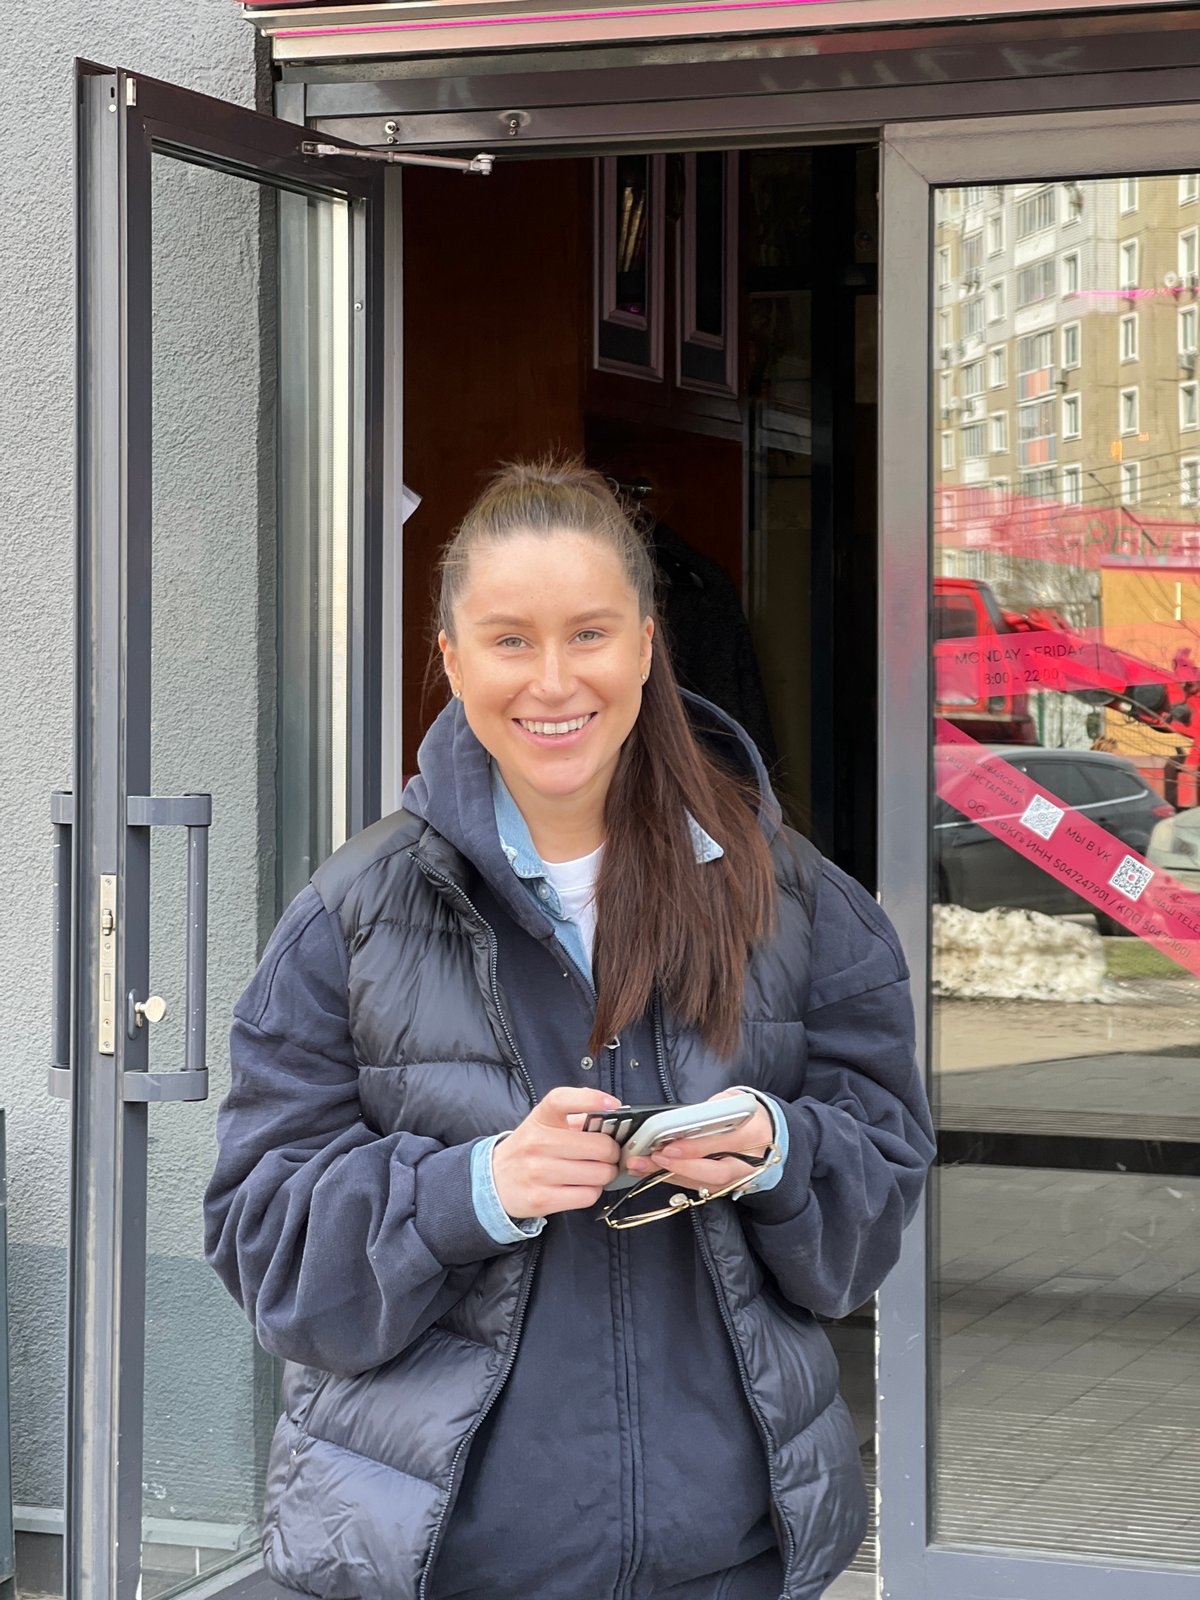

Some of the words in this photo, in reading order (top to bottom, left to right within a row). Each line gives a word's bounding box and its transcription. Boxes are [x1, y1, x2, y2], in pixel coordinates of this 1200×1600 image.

[1048, 515, 1171, 565] OPEN
[955, 647, 1021, 665] MONDAY
[1034, 644, 1084, 659] FRIDAY
[1065, 827, 1086, 845] МЫ
[1097, 848, 1112, 862] VK
[1026, 840, 1053, 862] ИНН
[1053, 858, 1109, 901] 5047247901
[1116, 903, 1142, 924] КПП
